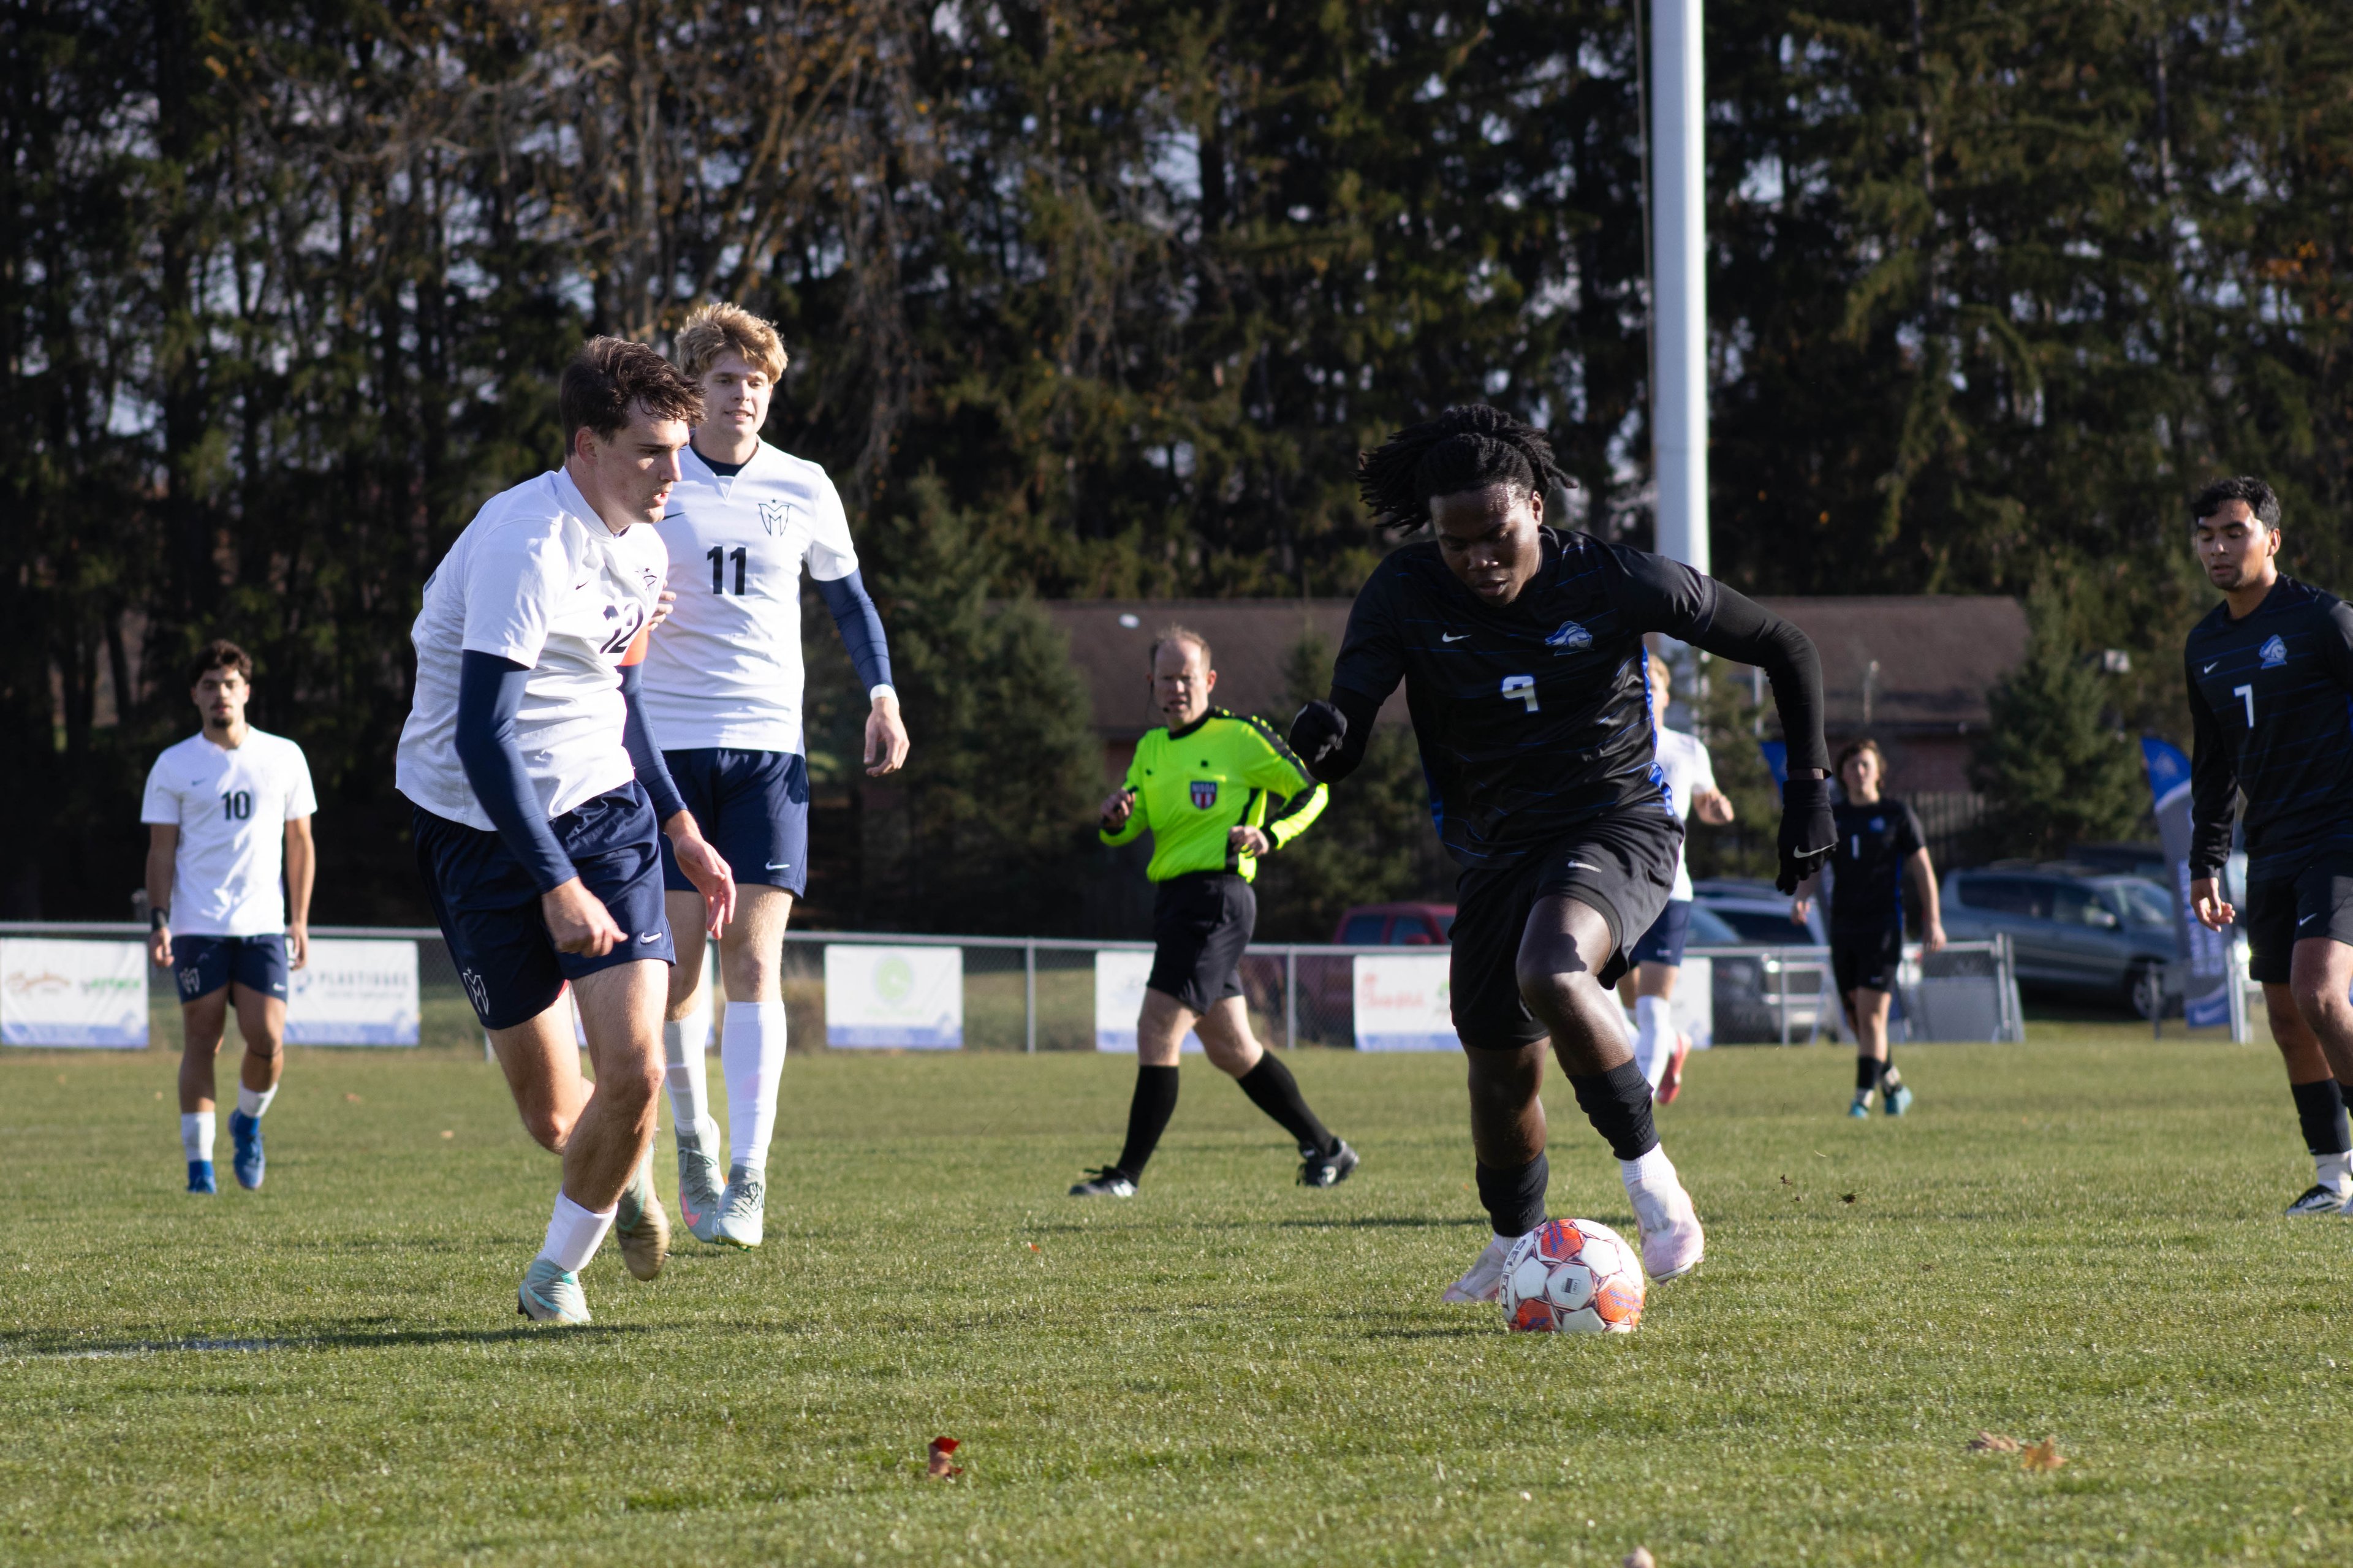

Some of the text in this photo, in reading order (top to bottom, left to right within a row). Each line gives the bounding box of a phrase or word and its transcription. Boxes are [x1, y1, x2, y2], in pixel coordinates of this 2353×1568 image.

[707, 545, 746, 596] 11
[599, 602, 644, 654] 12
[1501, 675, 1539, 713] 9
[2233, 683, 2254, 728] 7
[221, 790, 251, 820] 10
[1852, 834, 1860, 858] 1
[1501, 1239, 1526, 1312] SELECT
